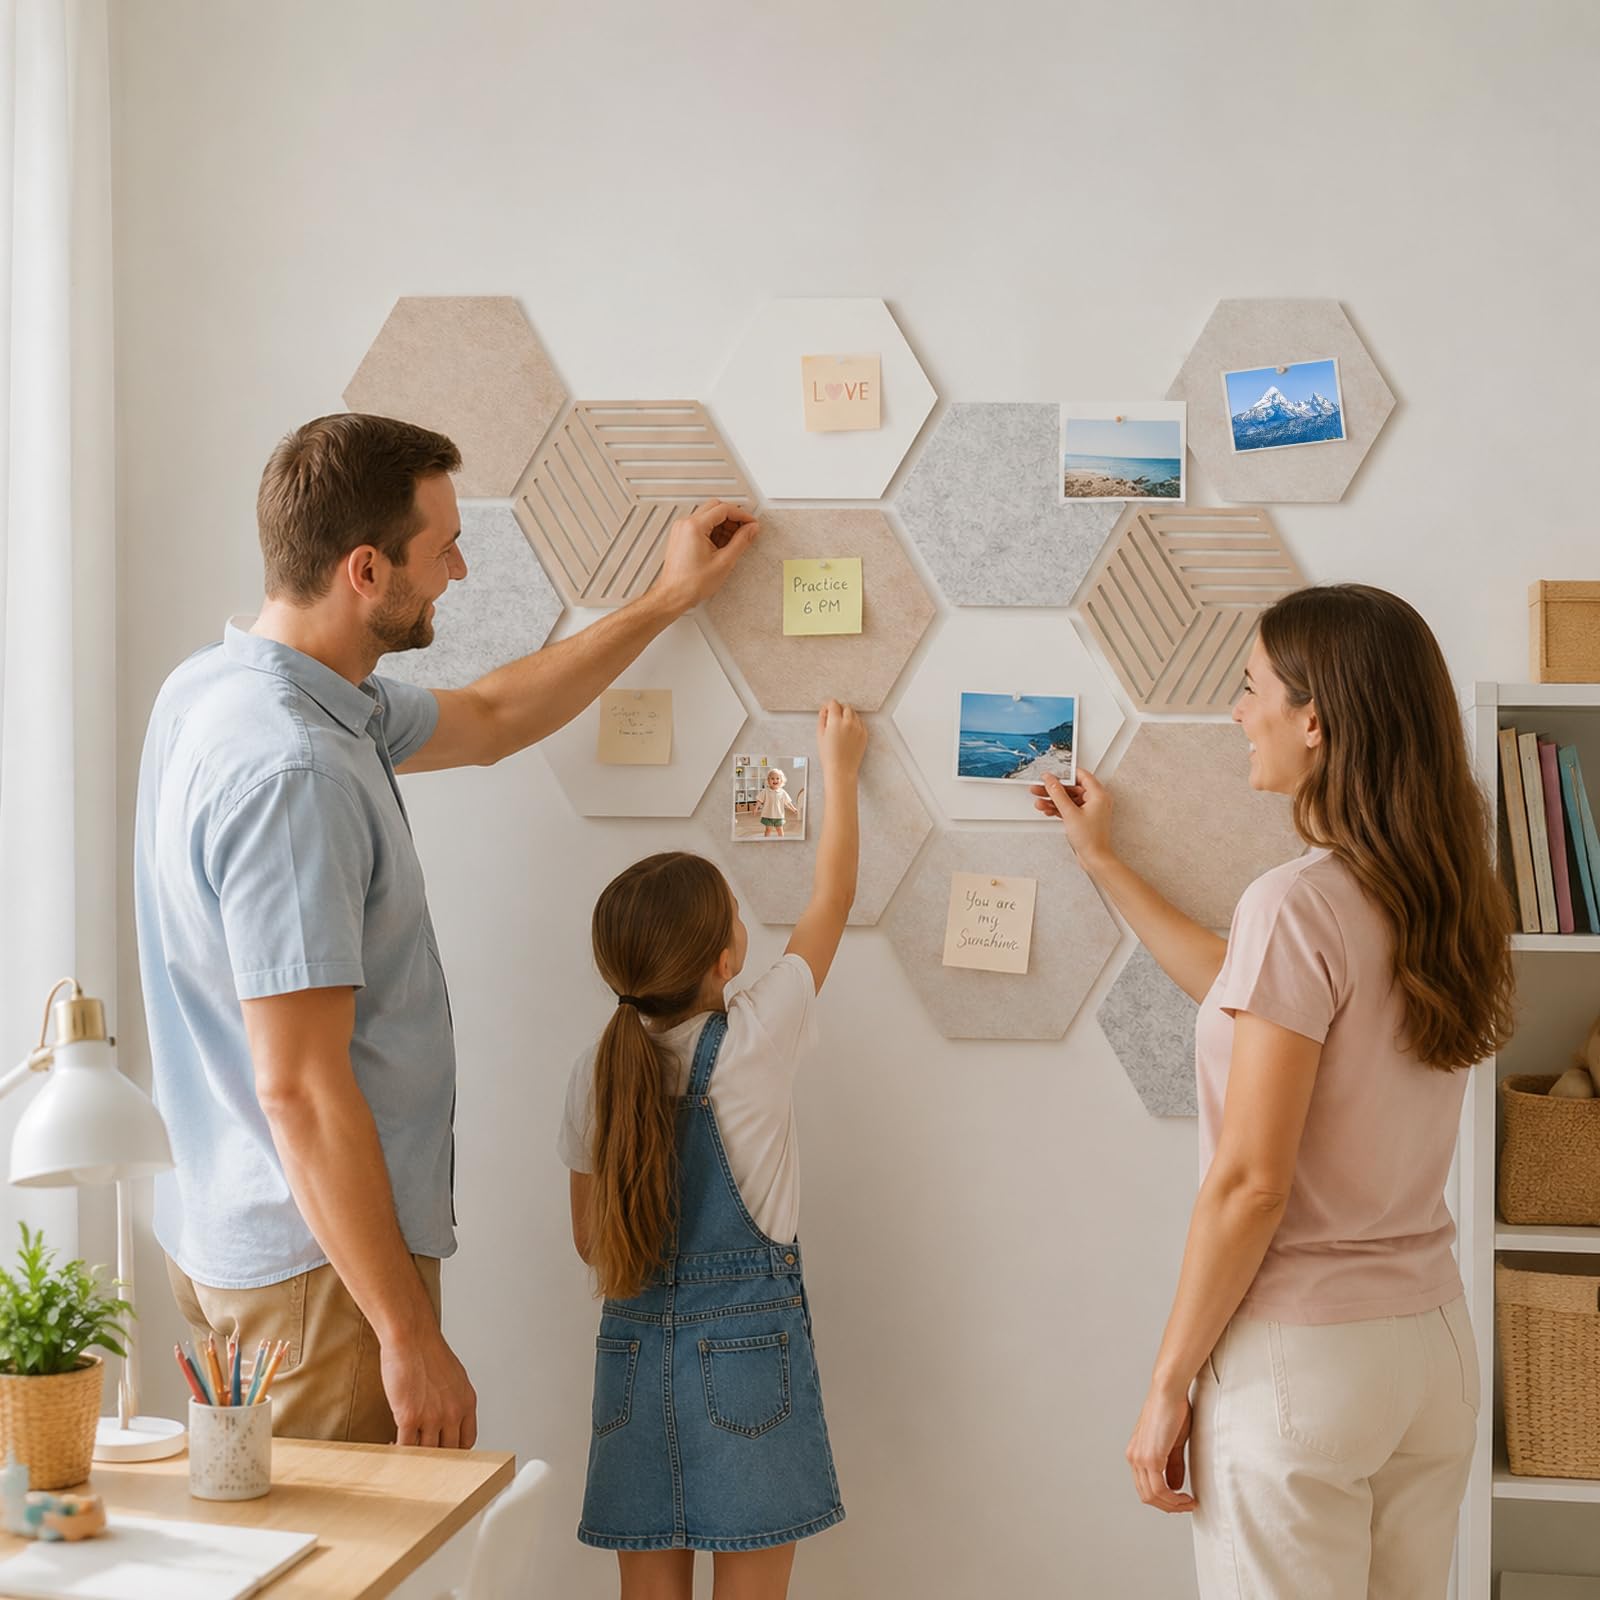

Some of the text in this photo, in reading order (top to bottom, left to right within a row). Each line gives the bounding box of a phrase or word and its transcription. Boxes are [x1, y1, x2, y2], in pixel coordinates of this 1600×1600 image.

[793, 577, 848, 592] Practice
[803, 599, 840, 614] 6 PM
[965, 890, 1016, 911] You are
[977, 915, 999, 932] my
[956, 928, 1019, 950] Sunshine
